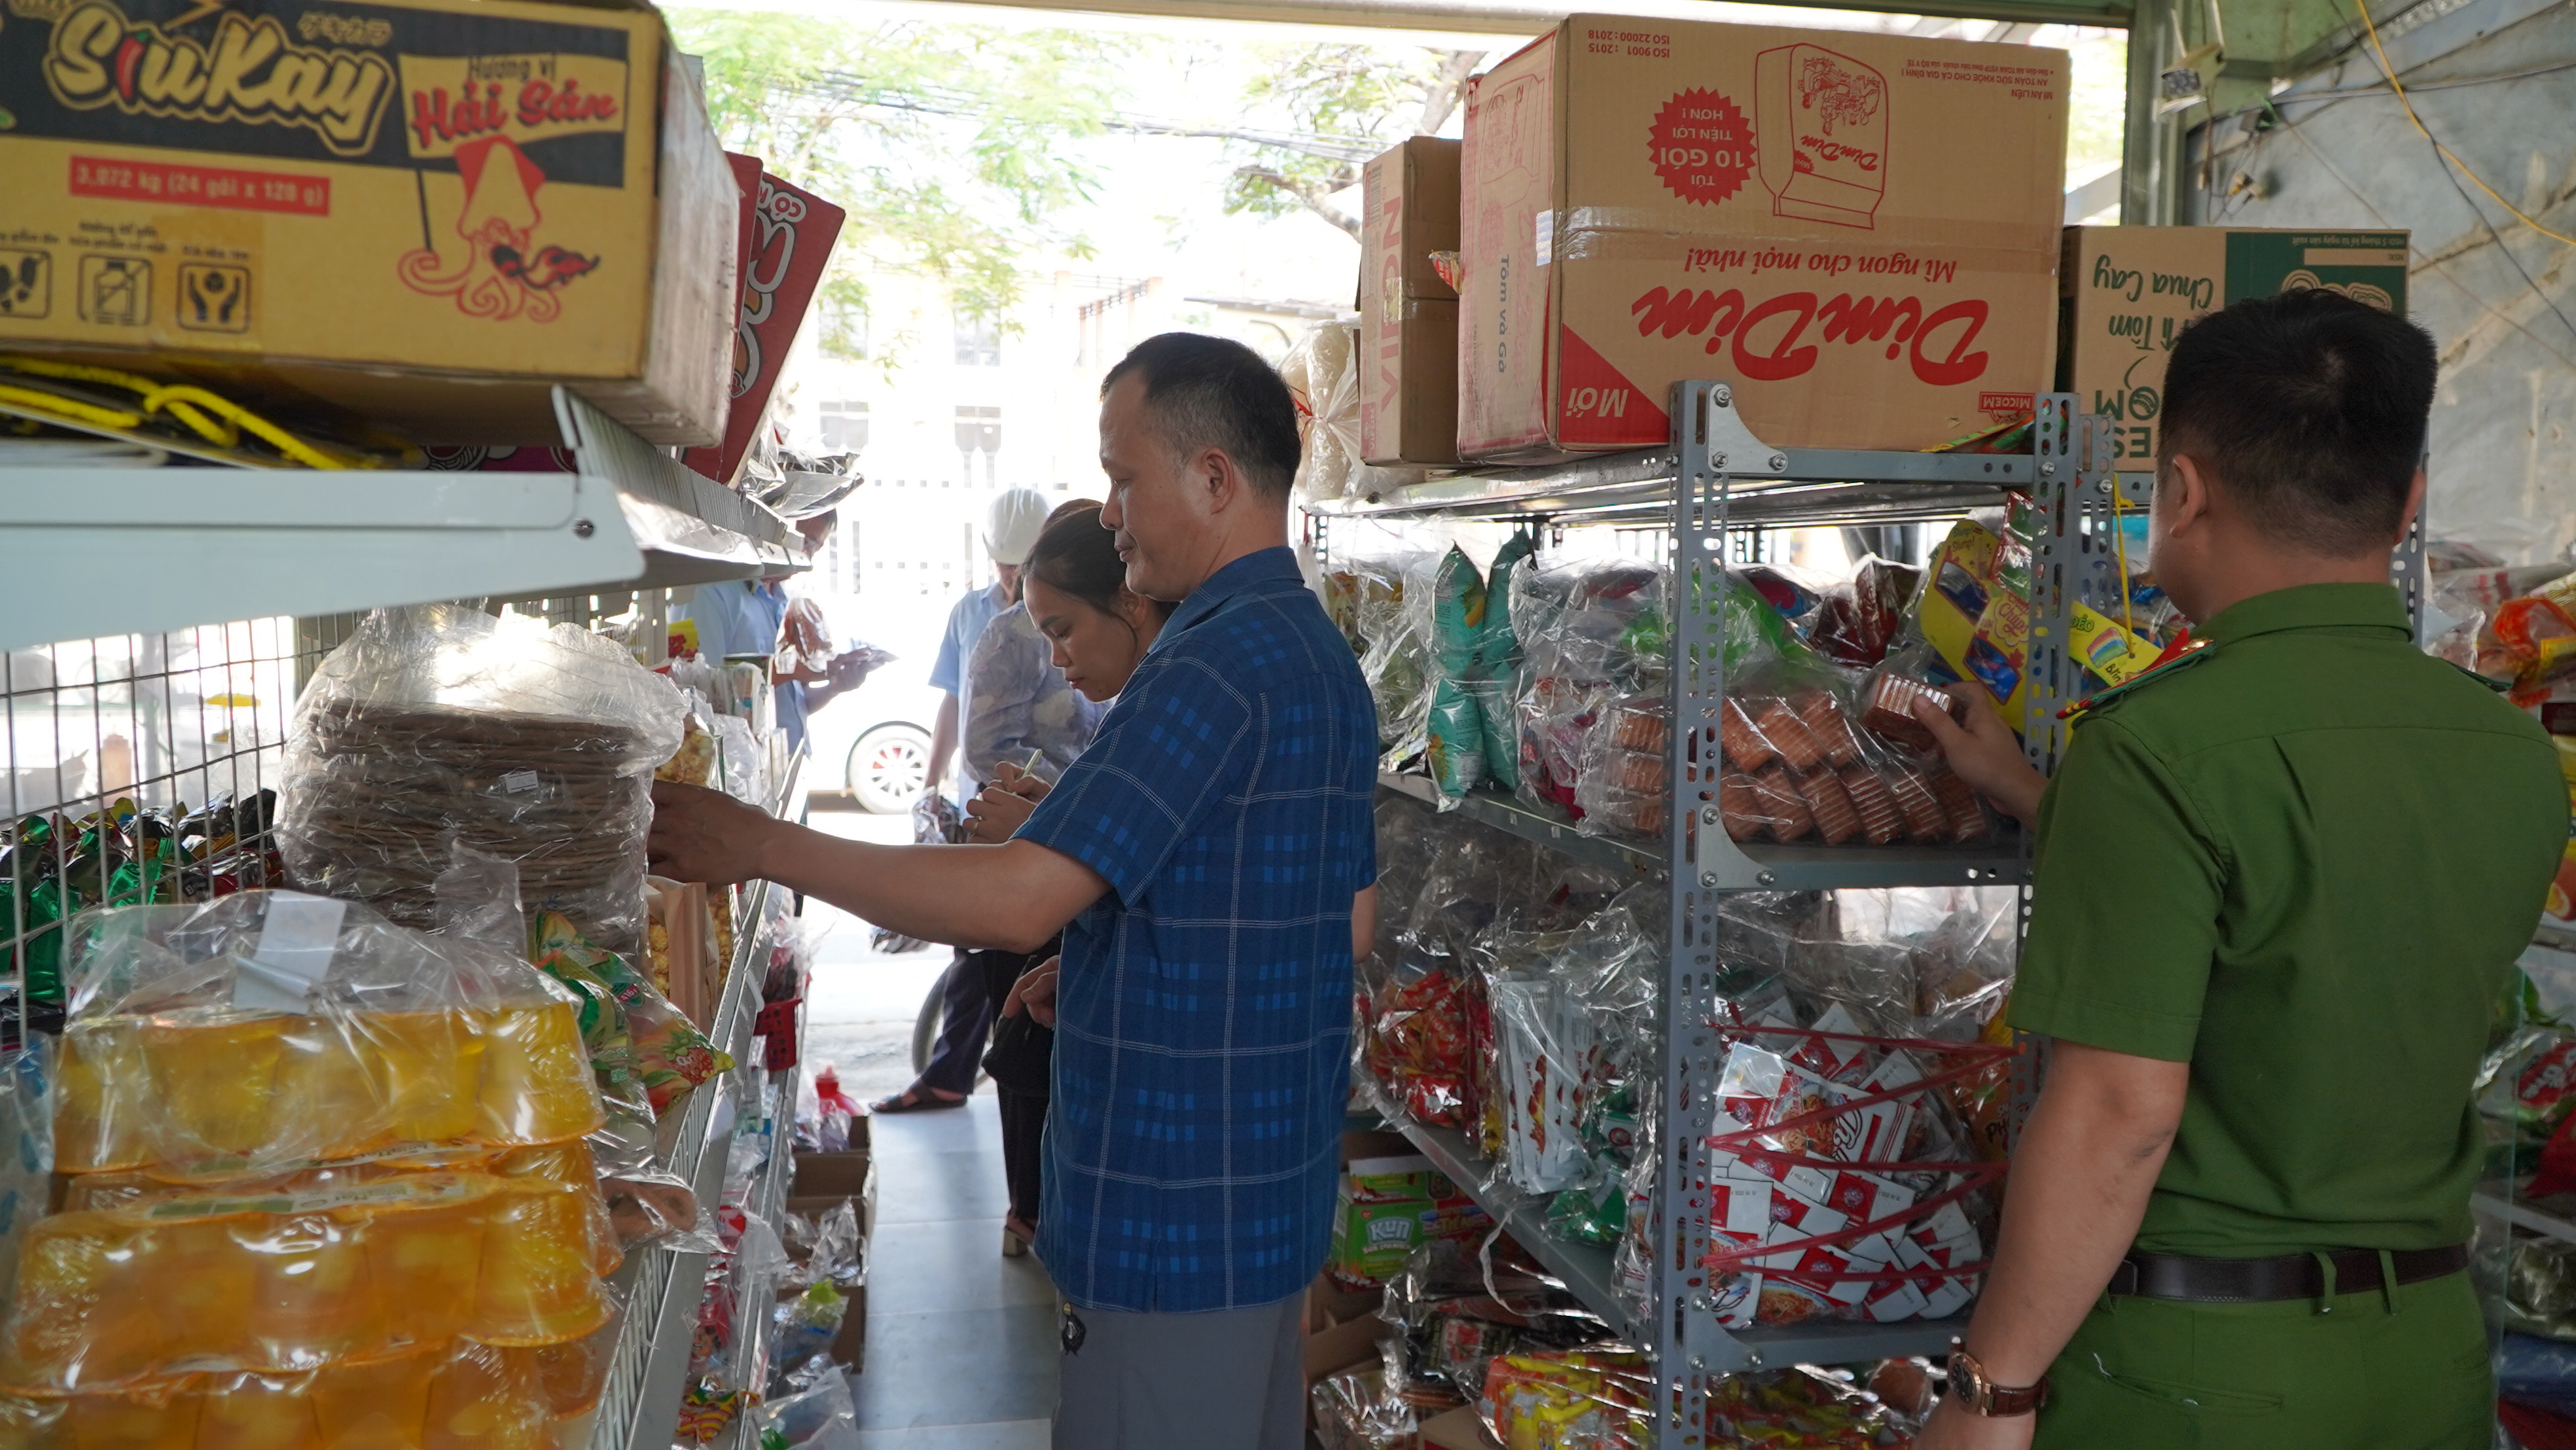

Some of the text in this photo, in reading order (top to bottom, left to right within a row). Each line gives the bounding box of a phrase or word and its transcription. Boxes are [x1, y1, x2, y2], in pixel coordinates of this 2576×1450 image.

[1652, 33, 1670, 44] ISO
[1627, 46, 1651, 57] 9001
[1653, 48, 1670, 58] ISO
[1954, 72, 1971, 80] CHO
[1690, 109, 1723, 120] HƠN
[1672, 127, 1733, 143] TIỆN LỢI
[1660, 147, 1745, 169] 10 GÓI
[138, 170, 162, 194] kg
[244, 183, 256, 198] x
[1690, 174, 1716, 187] TÚI
[1752, 249, 1802, 275] mọi
[1808, 253, 1851, 272] cho
[1858, 255, 1918, 275] ngon
[1925, 257, 1957, 283] Mì
[2093, 254, 2214, 310] Chua Cay
[1497, 253, 1511, 374] Tôm và Gà
[2109, 315, 2155, 351] Tôm
